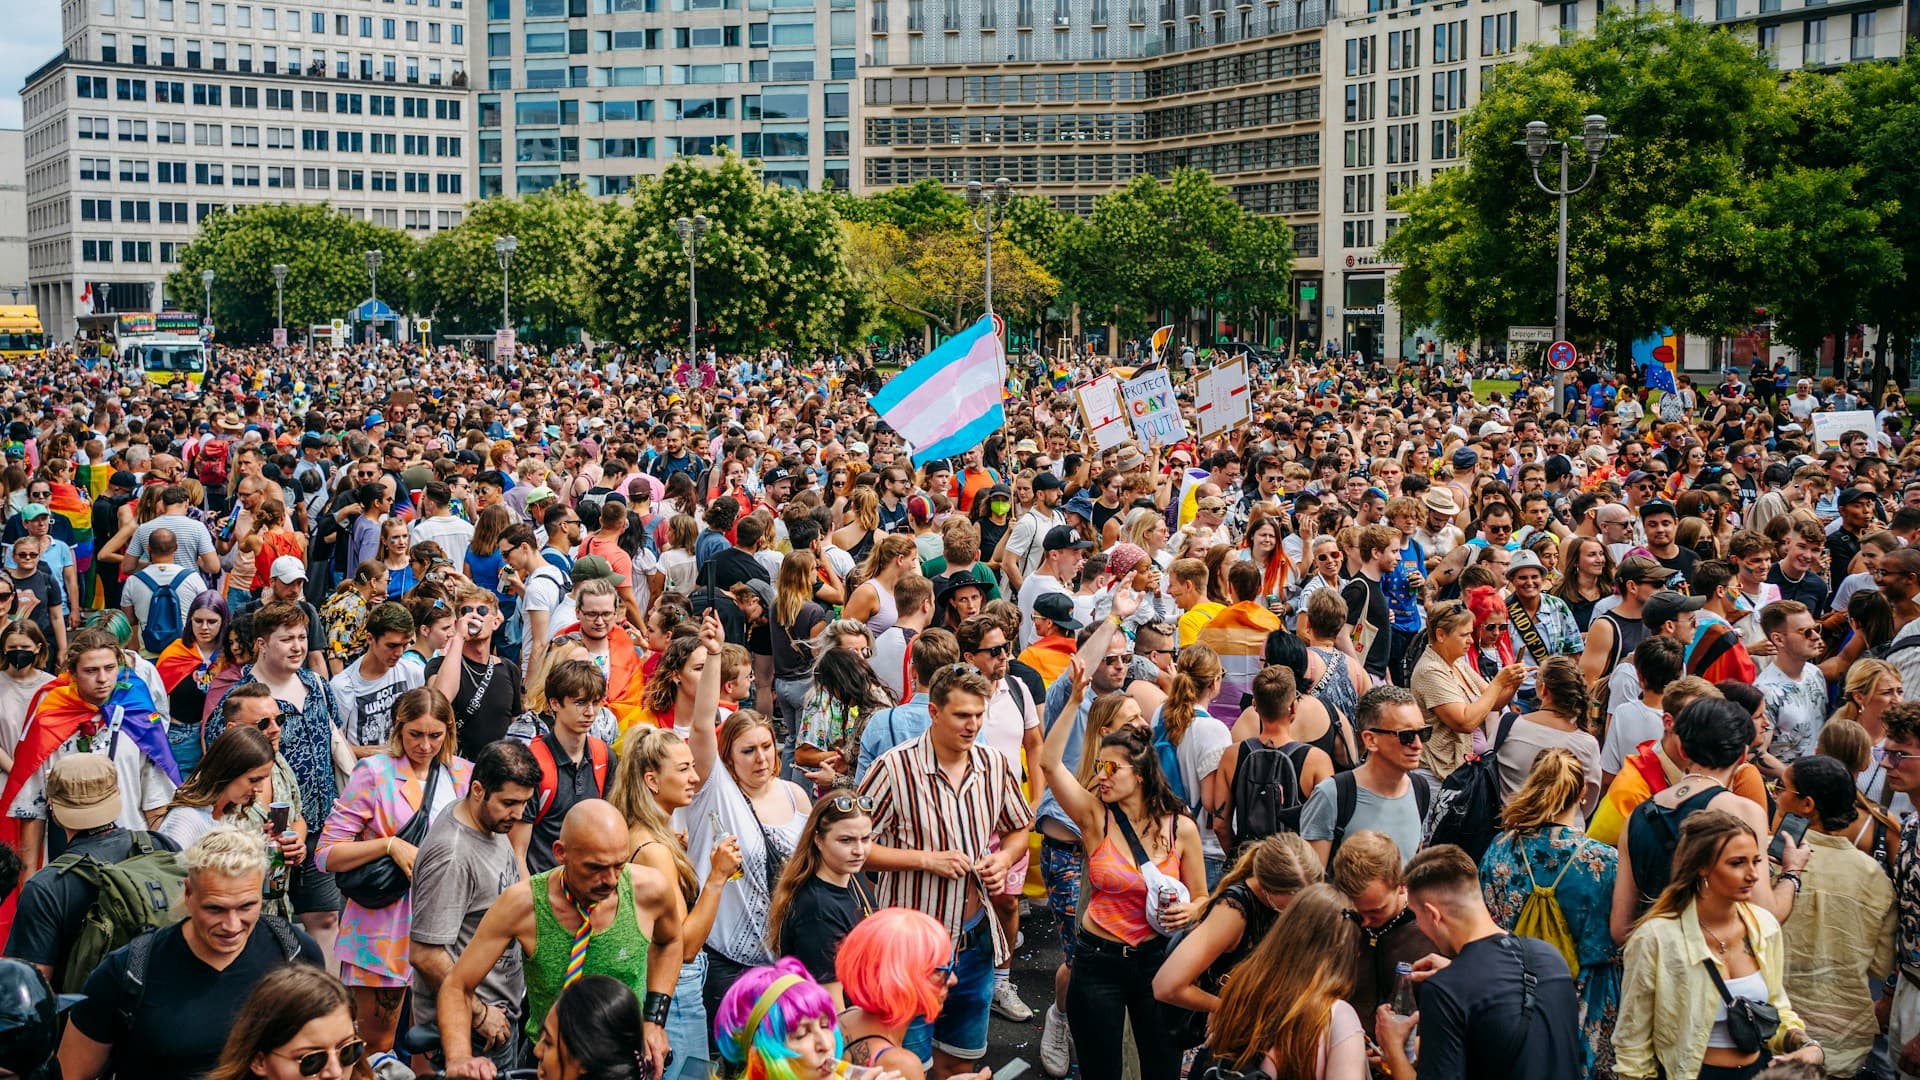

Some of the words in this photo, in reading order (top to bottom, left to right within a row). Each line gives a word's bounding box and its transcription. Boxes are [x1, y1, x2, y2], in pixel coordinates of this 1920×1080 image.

[1511, 330, 1536, 339] Leipziger
[1538, 330, 1551, 338] Platz
[1124, 375, 1166, 399] PROTECT
[1133, 392, 1167, 420] GAY
[1137, 411, 1181, 441] YOUTH
[1508, 601, 1531, 631] MAID
[1523, 631, 1542, 646] OF
